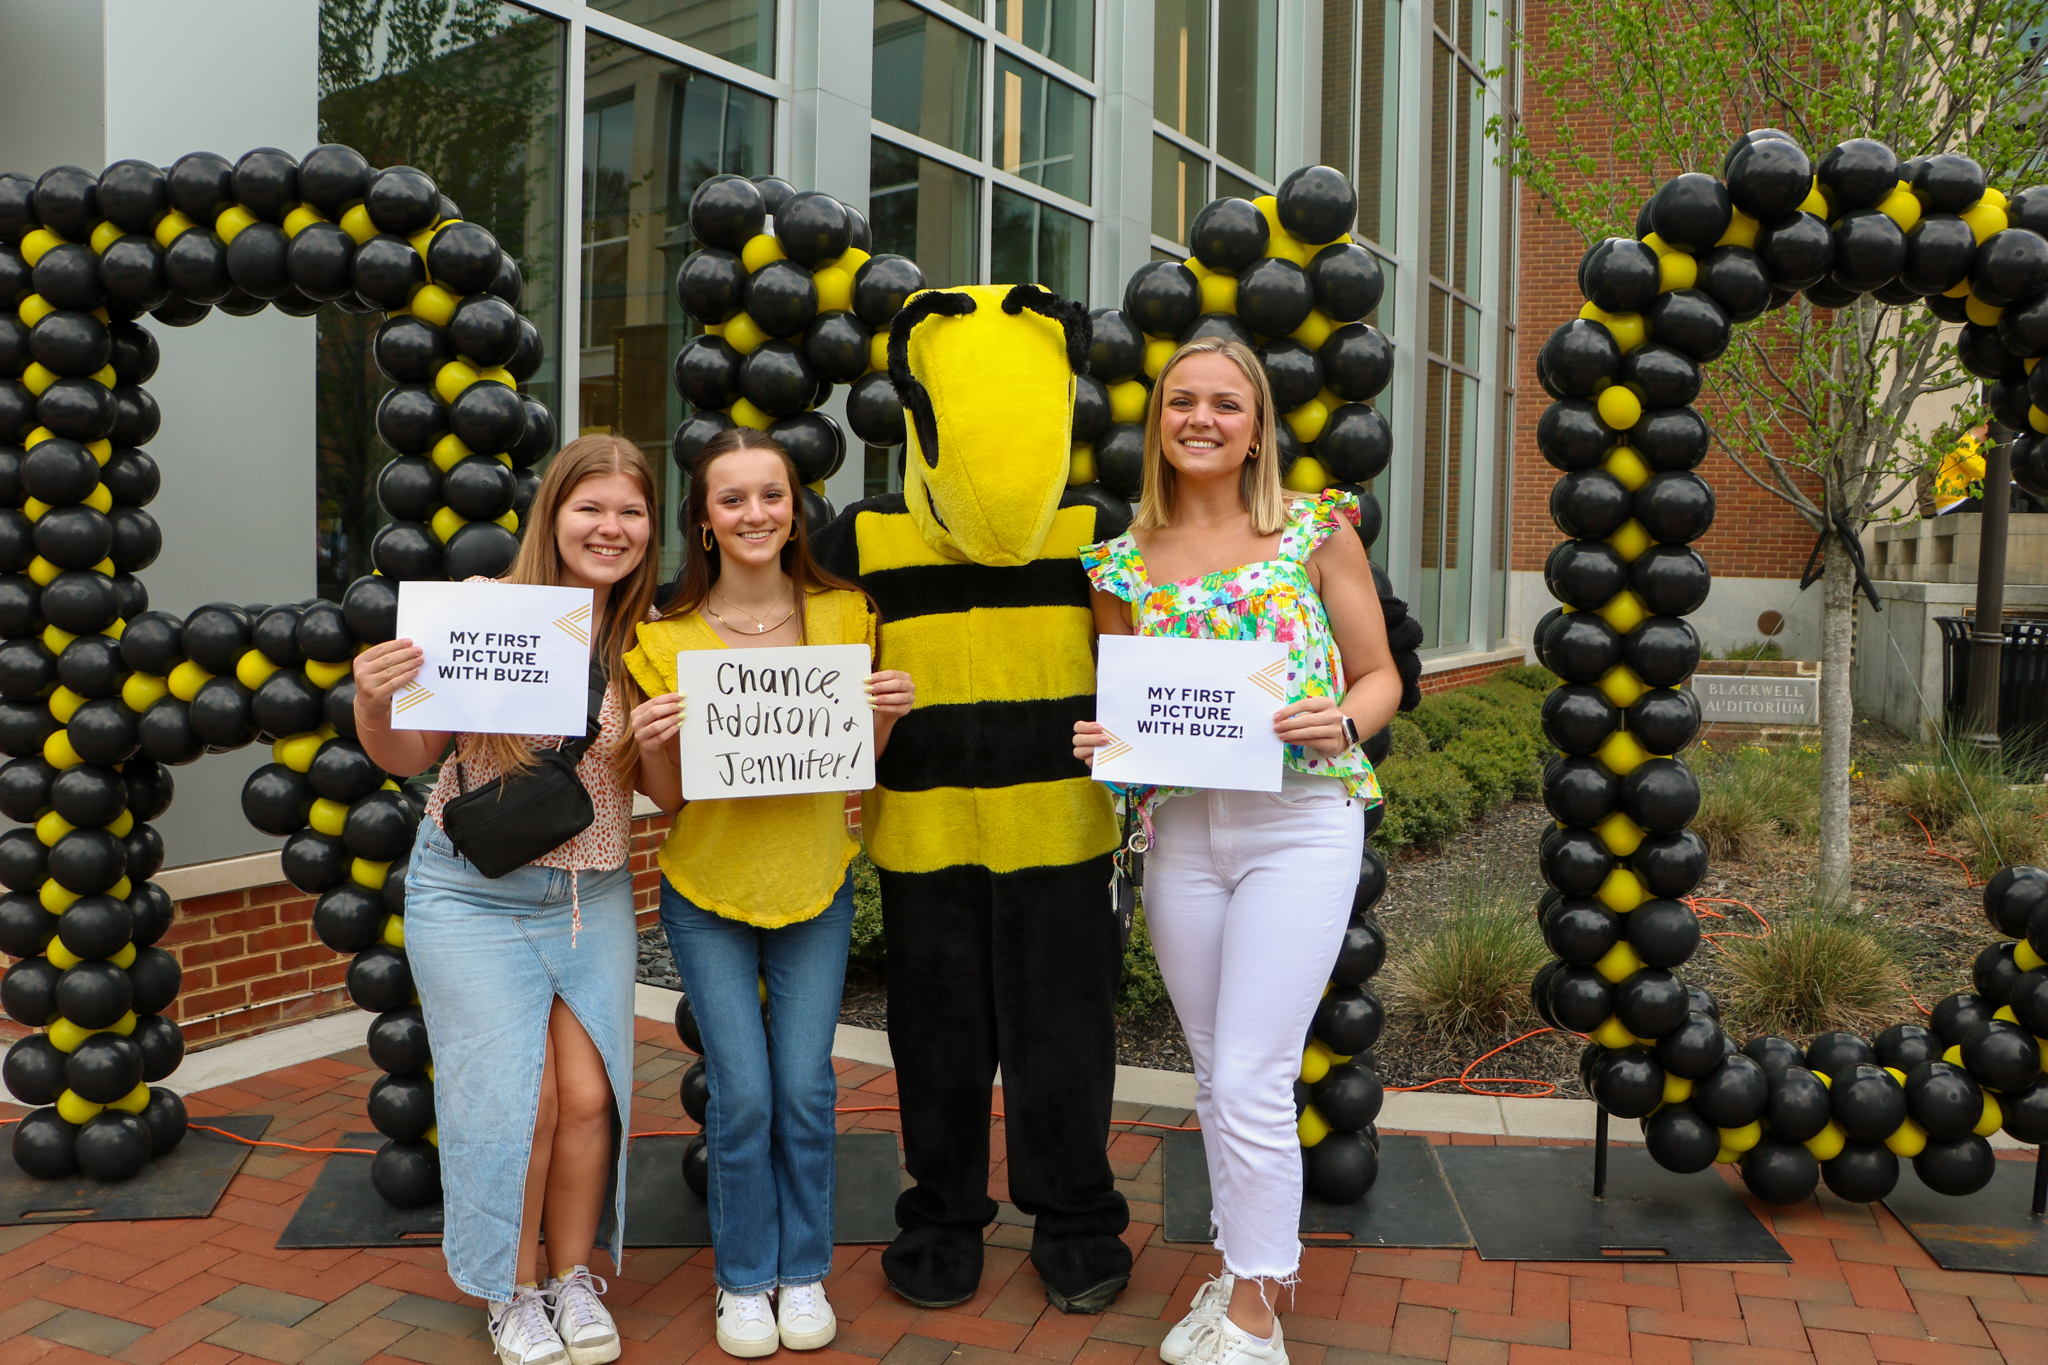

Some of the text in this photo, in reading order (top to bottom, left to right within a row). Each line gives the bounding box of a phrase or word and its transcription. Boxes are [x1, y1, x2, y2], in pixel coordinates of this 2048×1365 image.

[450, 631, 541, 648] MY FIRST
[452, 648, 537, 665] PICTURE
[438, 665, 549, 684] WITH BUZZ!
[1148, 686, 1236, 704] MY FIRST
[1708, 683, 1803, 698] BLACKWELL
[1150, 703, 1231, 721] PICTURE
[1705, 699, 1805, 715] AUDITORIUM
[706, 701, 831, 738] Addison
[1137, 719, 1244, 739] WITH BUZZ!
[715, 741, 863, 787] Jennifer!
